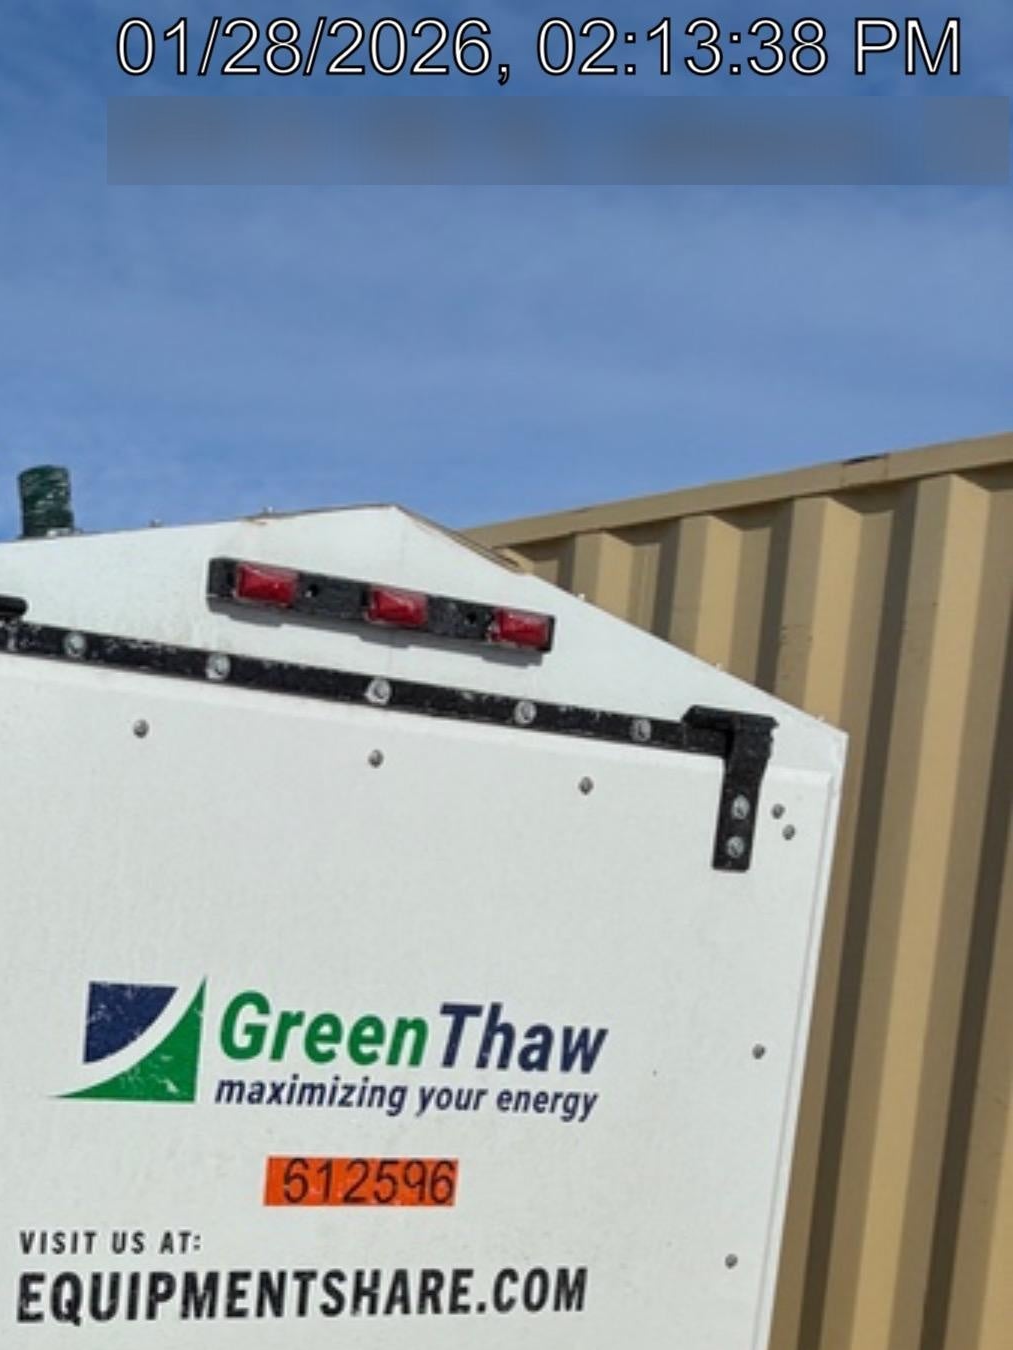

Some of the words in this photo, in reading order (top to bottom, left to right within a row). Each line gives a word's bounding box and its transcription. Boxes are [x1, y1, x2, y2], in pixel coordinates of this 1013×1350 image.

[219, 989, 609, 1075] GreenThaw
[214, 1074, 406, 1117] maximizing
[416, 1086, 486, 1117] your
[496, 1090, 597, 1122] energy
[282, 1159, 455, 1204] 612596
[19, 1231, 98, 1255] VISIT
[111, 1231, 145, 1254] US
[159, 1231, 201, 1254] AT:
[16, 1267, 588, 1326] EQUIPMENTSHARE.COM
